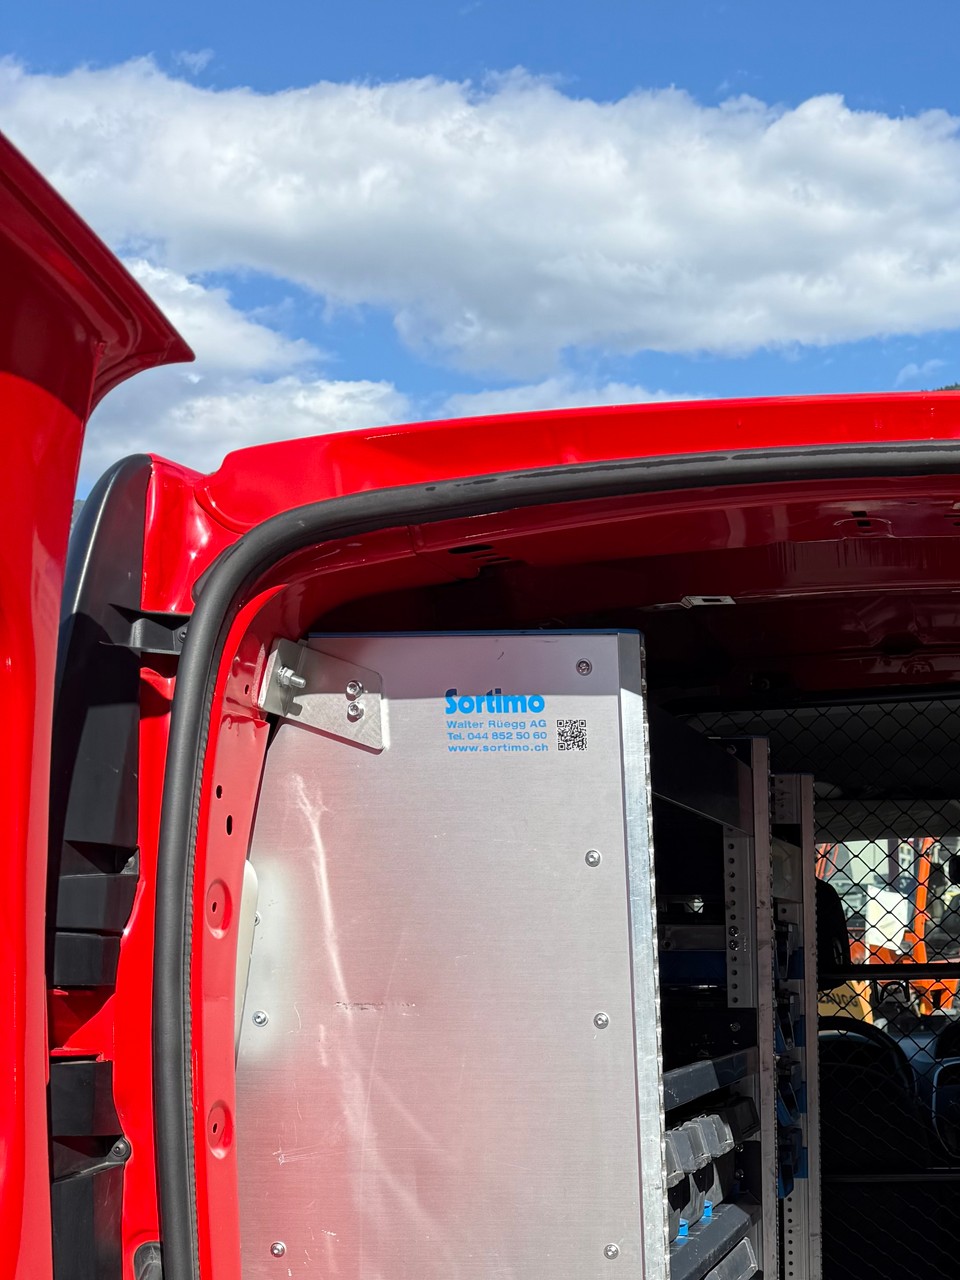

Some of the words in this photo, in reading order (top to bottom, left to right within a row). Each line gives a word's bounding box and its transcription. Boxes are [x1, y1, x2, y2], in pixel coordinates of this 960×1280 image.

[445, 688, 545, 714] Sortimo
[446, 720, 484, 729] Walter
[488, 719, 526, 730] Rüegg
[530, 719, 548, 728] AG
[447, 732, 465, 740] Tel.
[467, 732, 489, 740] 044
[491, 731, 514, 740] 852
[516, 731, 530, 740] 50
[533, 731, 548, 740] 60
[448, 743, 549, 752] www.sortimo.ch
